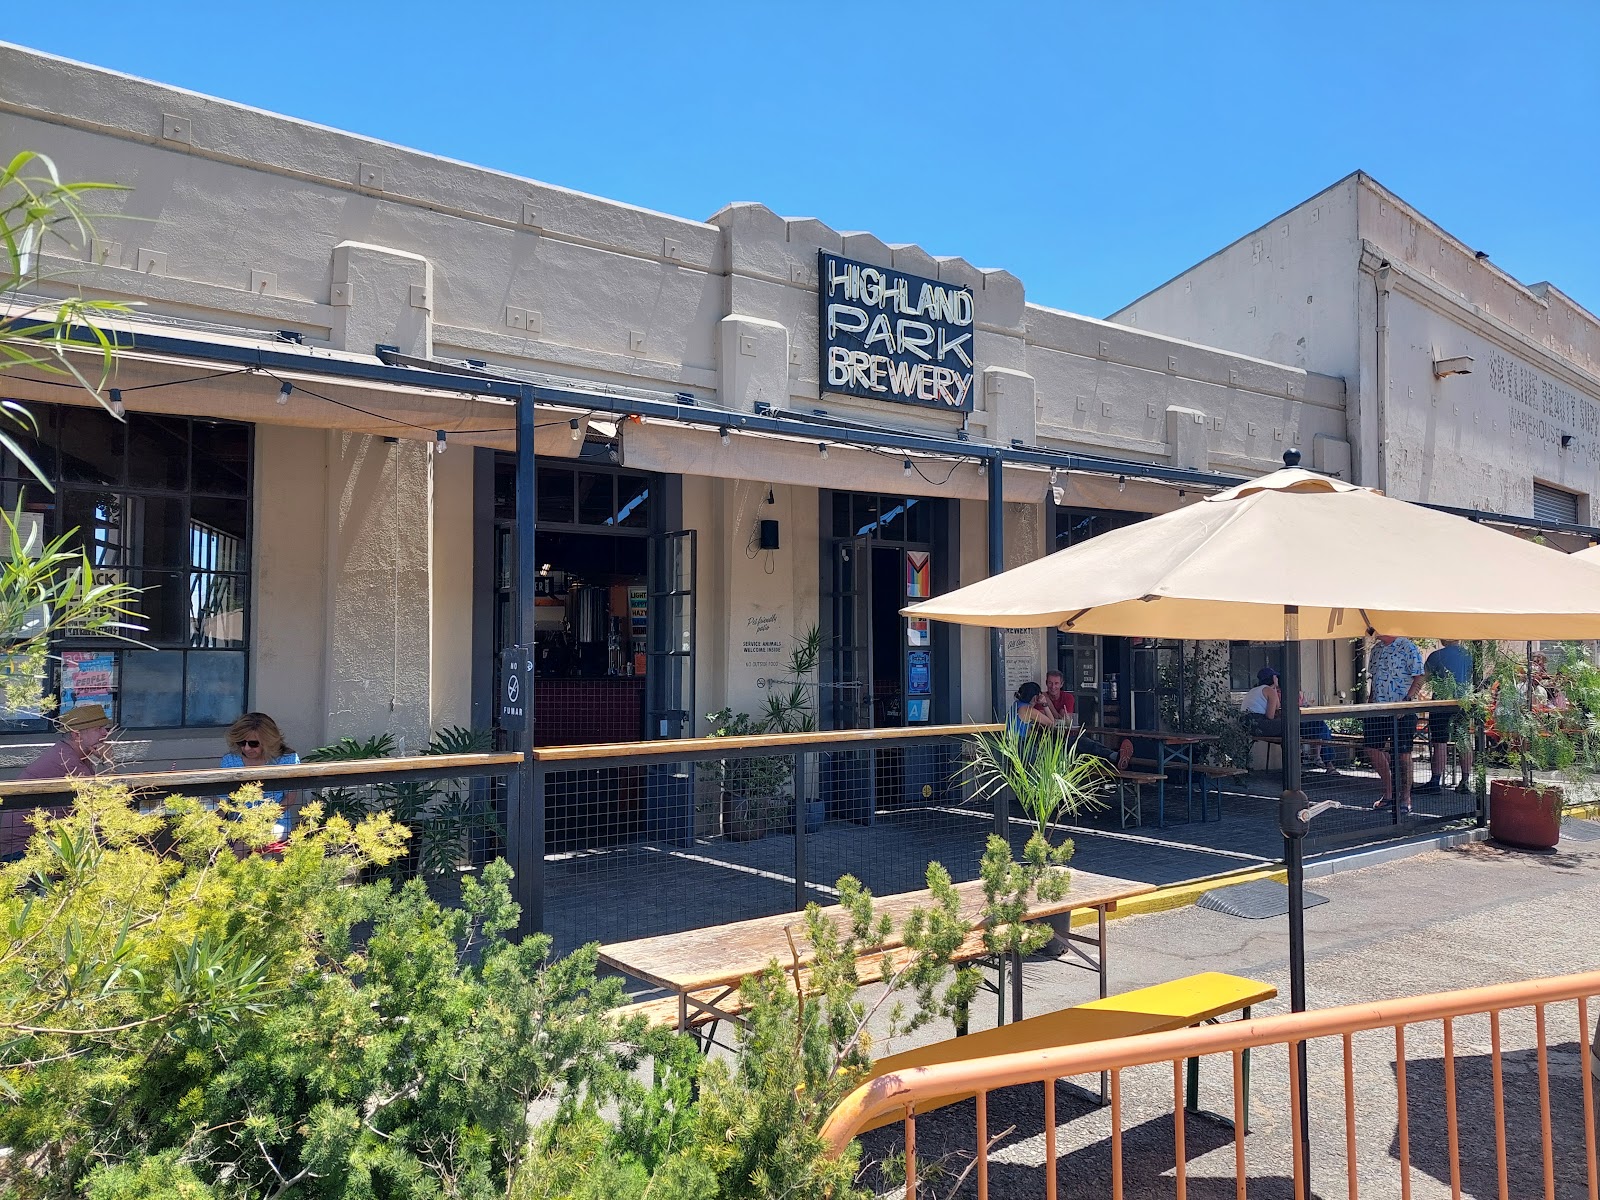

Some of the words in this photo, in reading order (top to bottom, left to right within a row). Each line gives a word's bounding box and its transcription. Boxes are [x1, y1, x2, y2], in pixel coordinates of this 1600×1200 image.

[828, 259, 974, 326] HIGHLAND
[828, 303, 973, 368] PARK
[828, 346, 973, 406] BREWERY
[510, 662, 518, 670] NO
[76, 674, 106, 687] PEOPLE
[503, 706, 523, 717] FUMAR
[909, 704, 919, 717] A
